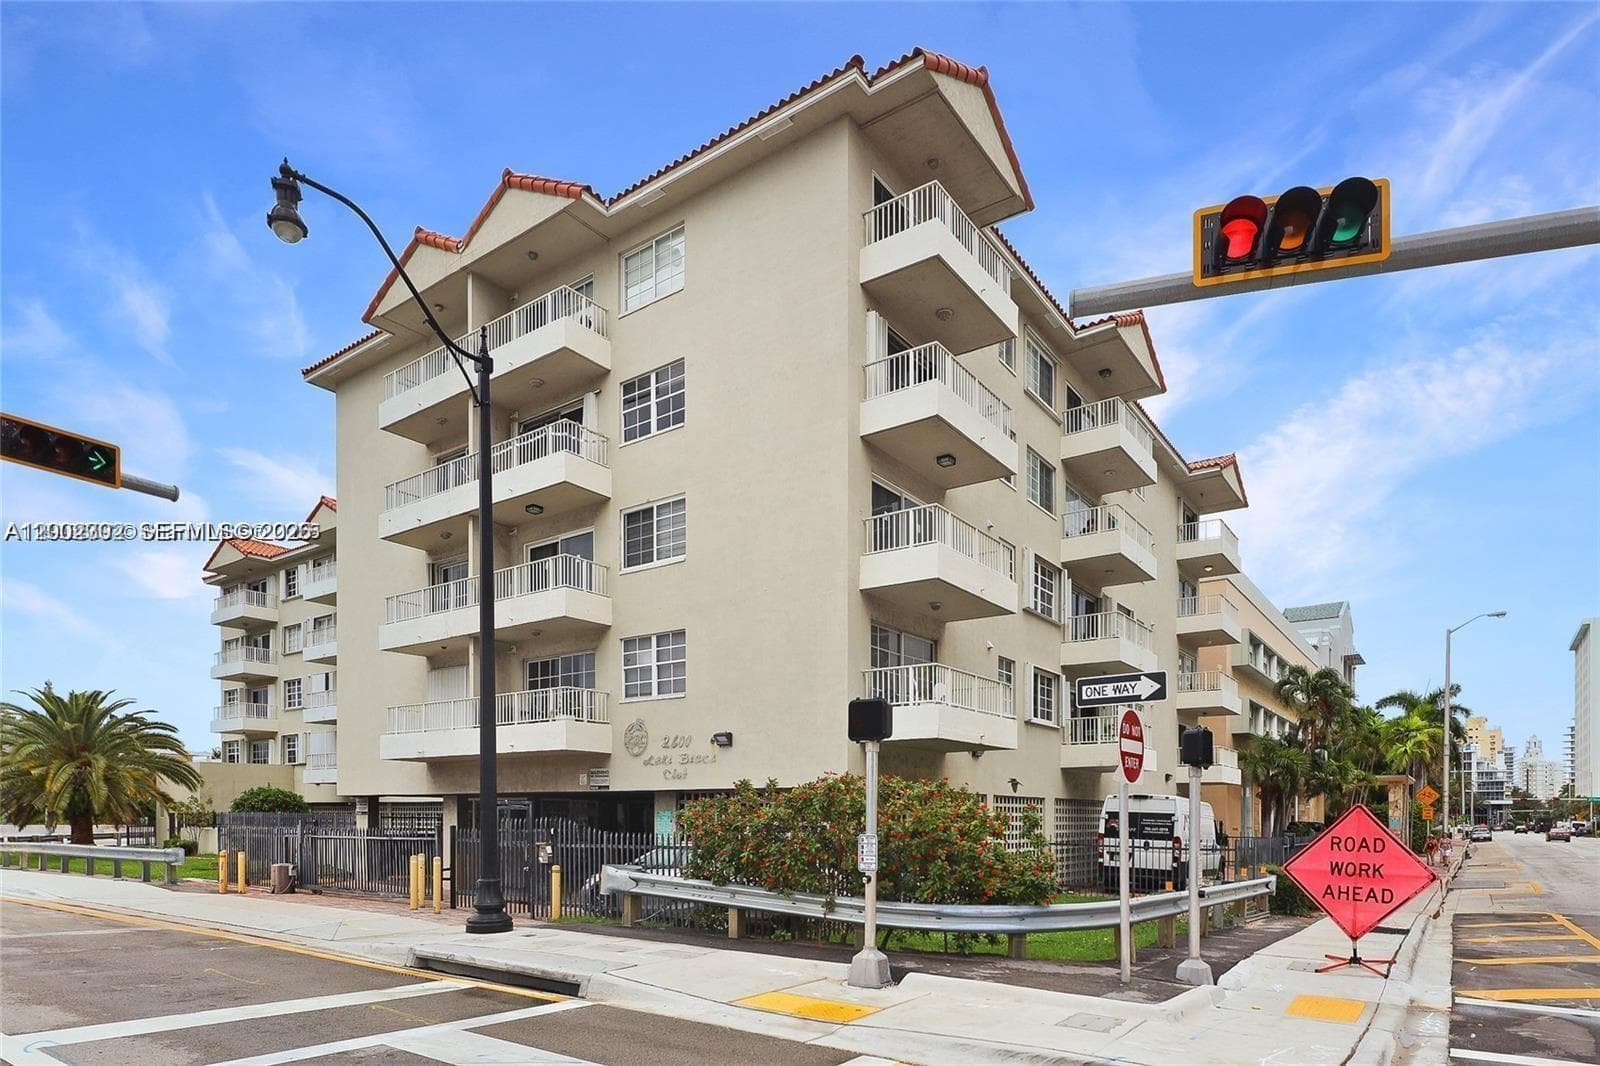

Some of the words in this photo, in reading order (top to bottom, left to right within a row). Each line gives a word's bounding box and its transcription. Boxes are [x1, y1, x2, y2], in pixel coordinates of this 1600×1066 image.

[1085, 685, 1108, 697] ONE
[1112, 683, 1137, 695] WAY
[1122, 723, 1130, 734] DO
[1131, 724, 1141, 737] NOT
[661, 735, 692, 749] 2600
[1124, 756, 1139, 769] ENTER
[1330, 836, 1386, 853] ROAD
[1329, 861, 1385, 879] WORK
[1322, 884, 1394, 904] AHEAD
